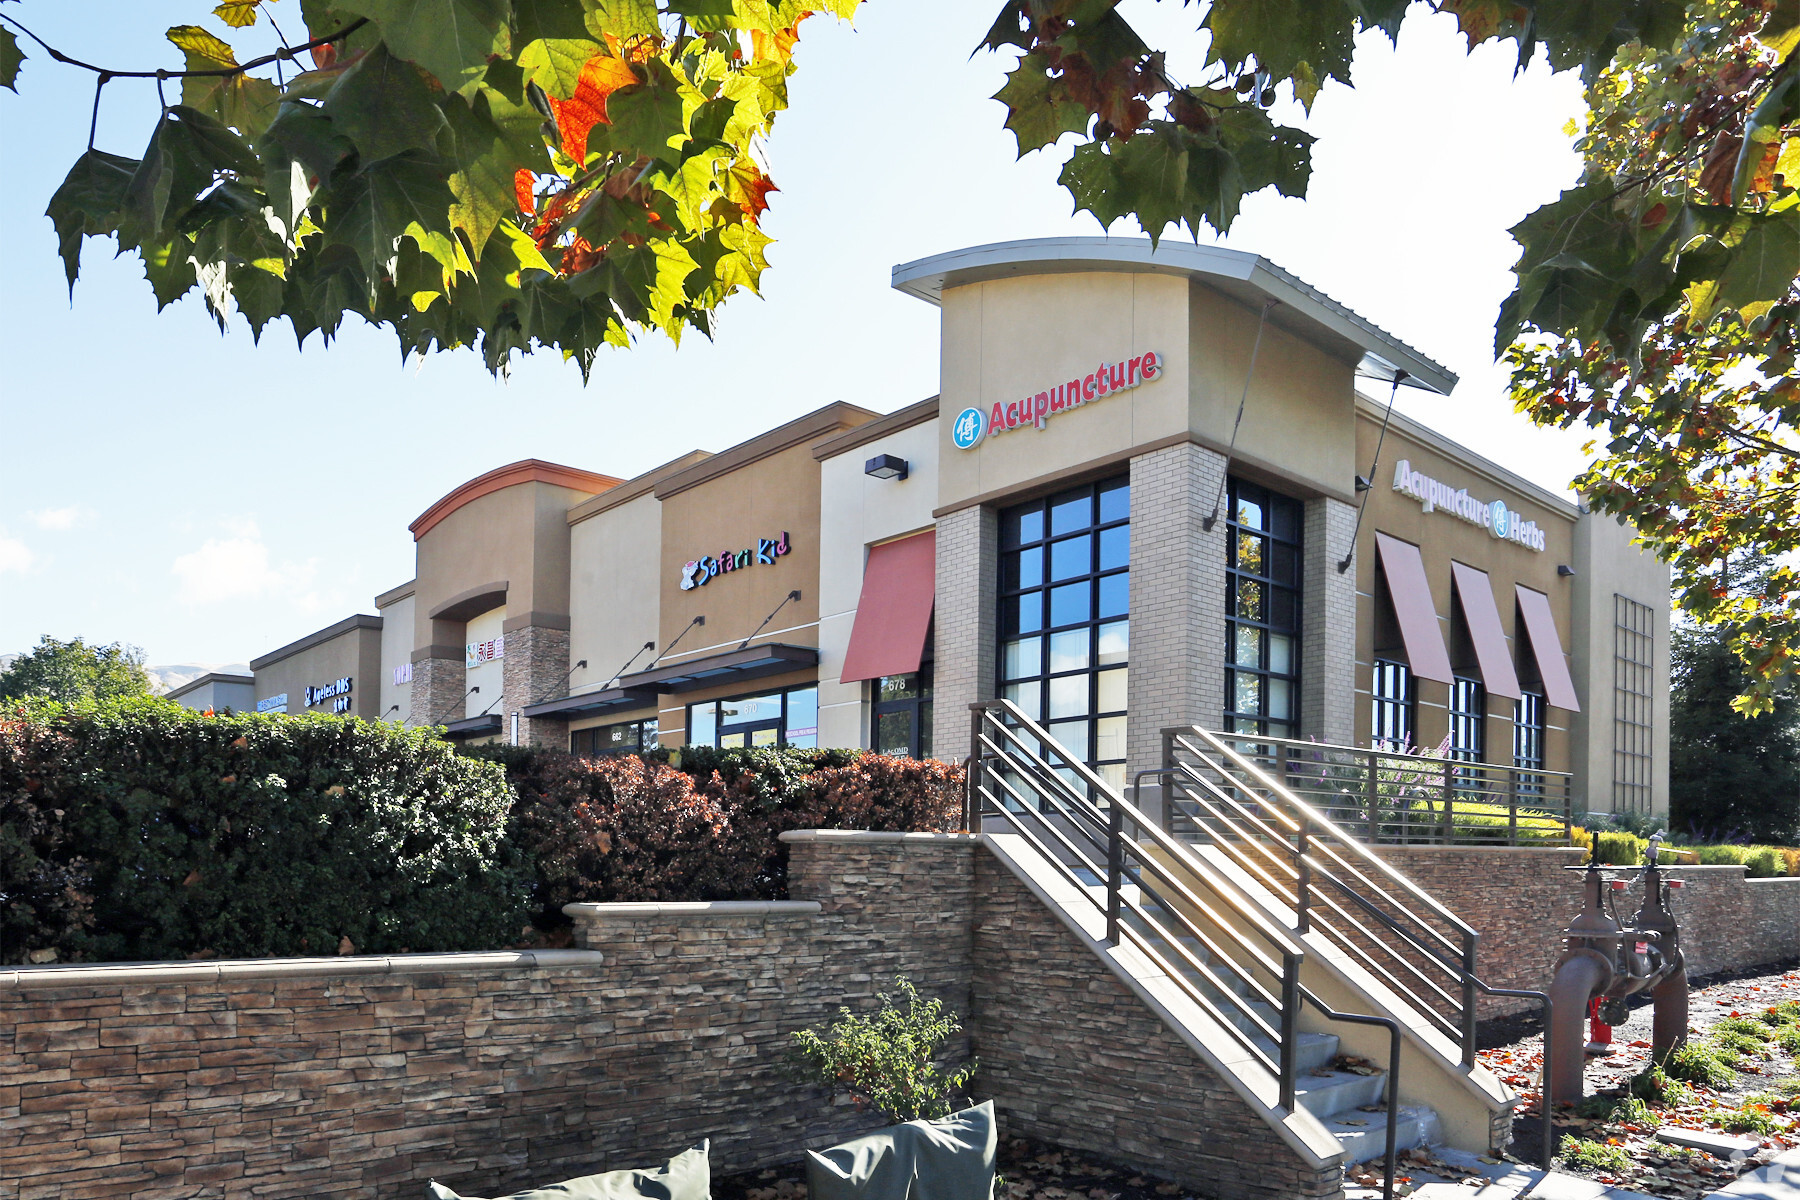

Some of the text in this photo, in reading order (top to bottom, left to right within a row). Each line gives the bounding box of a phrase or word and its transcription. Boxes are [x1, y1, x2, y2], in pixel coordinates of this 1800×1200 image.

[987, 351, 1160, 435] Acupuncture
[1394, 459, 1490, 528] Acupuncture
[1509, 510, 1545, 552] Herbs
[698, 530, 788, 586] Safari Kid
[312, 684, 336, 705] Ageless
[335, 677, 350, 695] DDS
[888, 679, 906, 691] 678
[743, 703, 757, 714] 670
